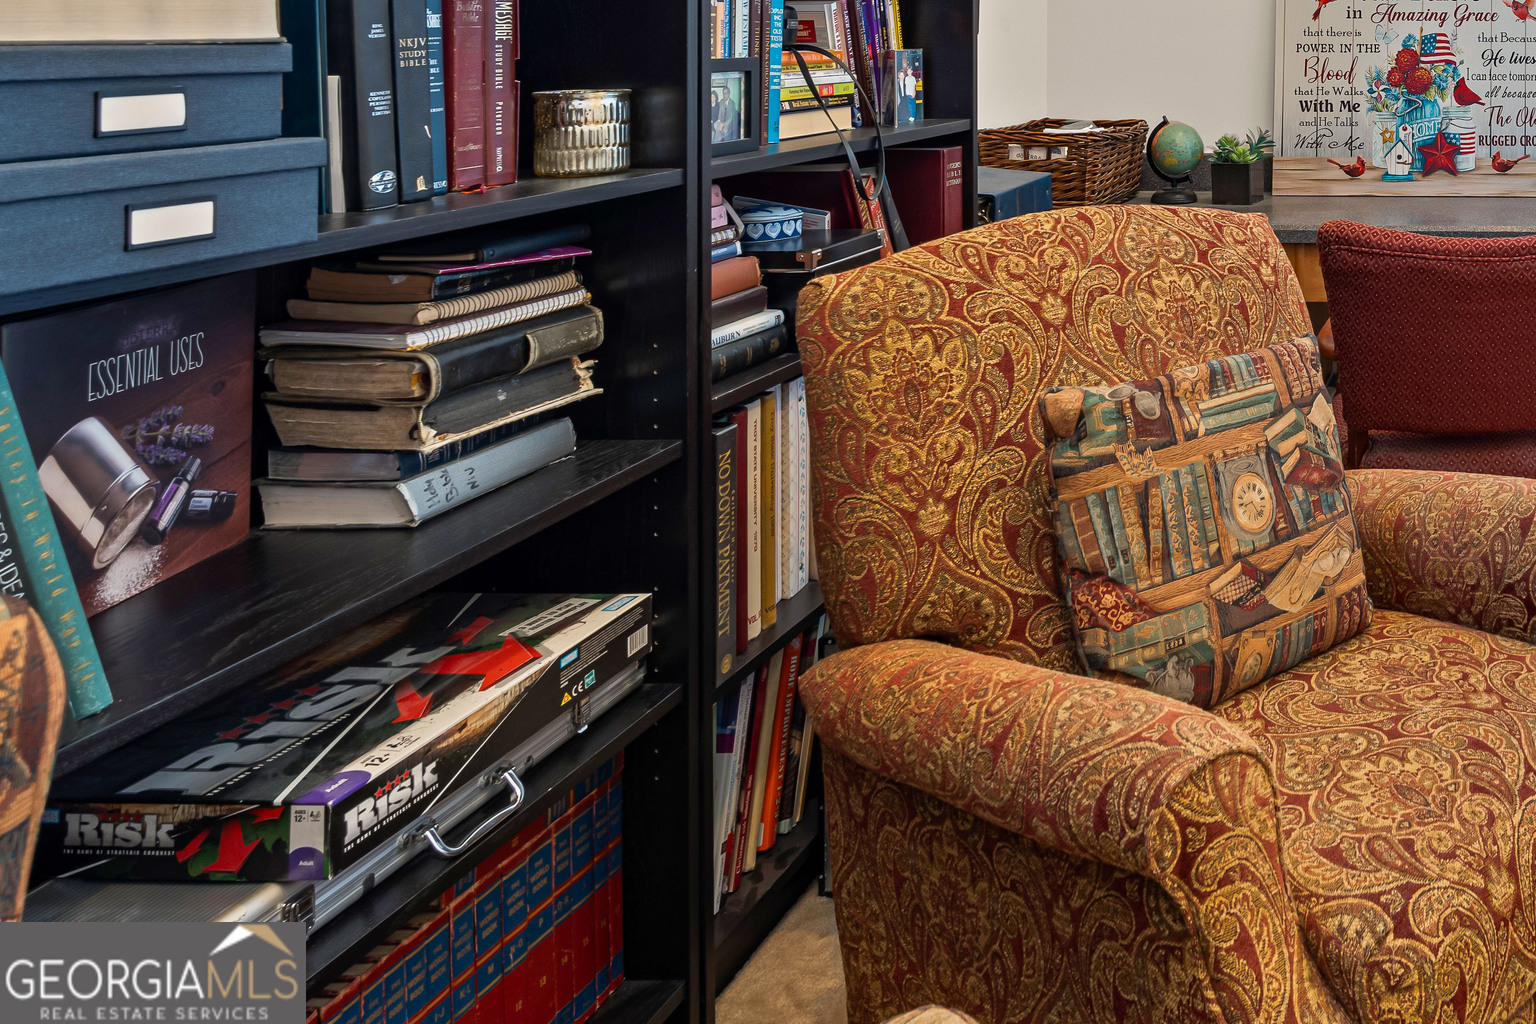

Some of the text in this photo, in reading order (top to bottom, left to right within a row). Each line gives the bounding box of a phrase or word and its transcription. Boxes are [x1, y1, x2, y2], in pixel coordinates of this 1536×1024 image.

[456, 1, 483, 12] Builders
[461, 12, 480, 23] Bible
[494, 3, 513, 42] MESSAGE
[1346, 3, 1501, 29] in Amazing Grace
[1303, 27, 1362, 37] that there is
[1477, 33, 1498, 44] that
[399, 37, 427, 48] NKJV
[1295, 43, 1381, 53] POWER IN THE
[399, 50, 427, 59] STUDY
[494, 44, 503, 66] STUDY
[1481, 48, 1507, 68] He
[400, 59, 427, 67] BIBLE
[1304, 56, 1359, 85] Blood
[494, 68, 503, 90] BIBLE
[1466, 68, 1470, 81] I
[1470, 71, 1487, 82] can
[1488, 69, 1507, 82] face
[1294, 87, 1364, 97] that He Walks
[1484, 86, 1499, 99] all
[1500, 86, 1536, 99] because
[1299, 99, 1361, 113] With Me
[1299, 117, 1359, 127] and He Talks
[1484, 105, 1512, 128] The
[1294, 127, 1365, 152] With Me
[1478, 135, 1517, 148] RUGGED
[711, 330, 741, 346] AUBURN
[88, 332, 205, 402] ESSENTIAL USES
[718, 449, 731, 637] NO DOWN PAYMENT
[21, 497, 40, 521] in
[34, 531, 69, 598] World
[59, 608, 82, 648] War
[75, 659, 96, 683] II
[788, 655, 798, 687] HOME
[571, 681, 584, 697] CE
[778, 694, 793, 783] IMPROVEMENT
[343, 783, 440, 853] THE GAME OF STRATEGIC CONQUEST
[534, 858, 544, 868] THE
[530, 864, 550, 883] WORLD
[511, 880, 520, 890] THE
[532, 878, 548, 894] BOOK
[506, 887, 526, 905] WORLD
[508, 900, 524, 917] BOOK
[561, 954, 569, 966] 14
[487, 963, 494, 974] M
[539, 977, 547, 987] 13
